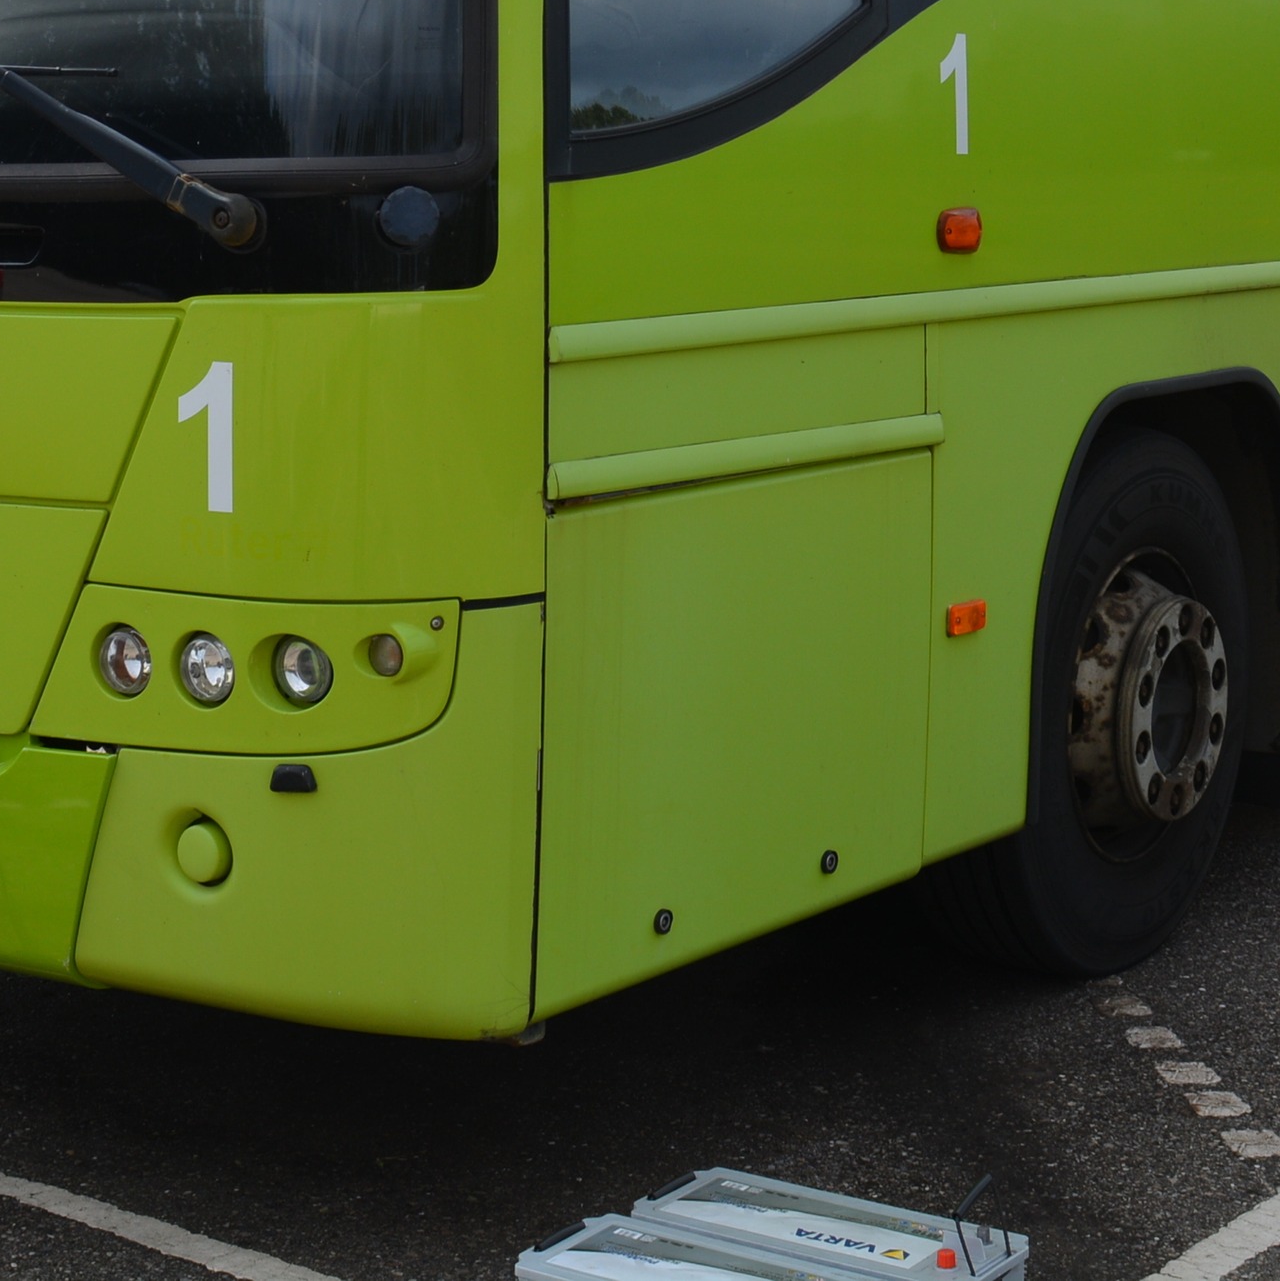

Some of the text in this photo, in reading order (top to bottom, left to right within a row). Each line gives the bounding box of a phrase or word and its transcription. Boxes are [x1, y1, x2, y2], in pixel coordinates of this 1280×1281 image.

[940, 33, 969, 155] 1
[177, 361, 233, 513] 1
[795, 1227, 877, 1254] VARTA
